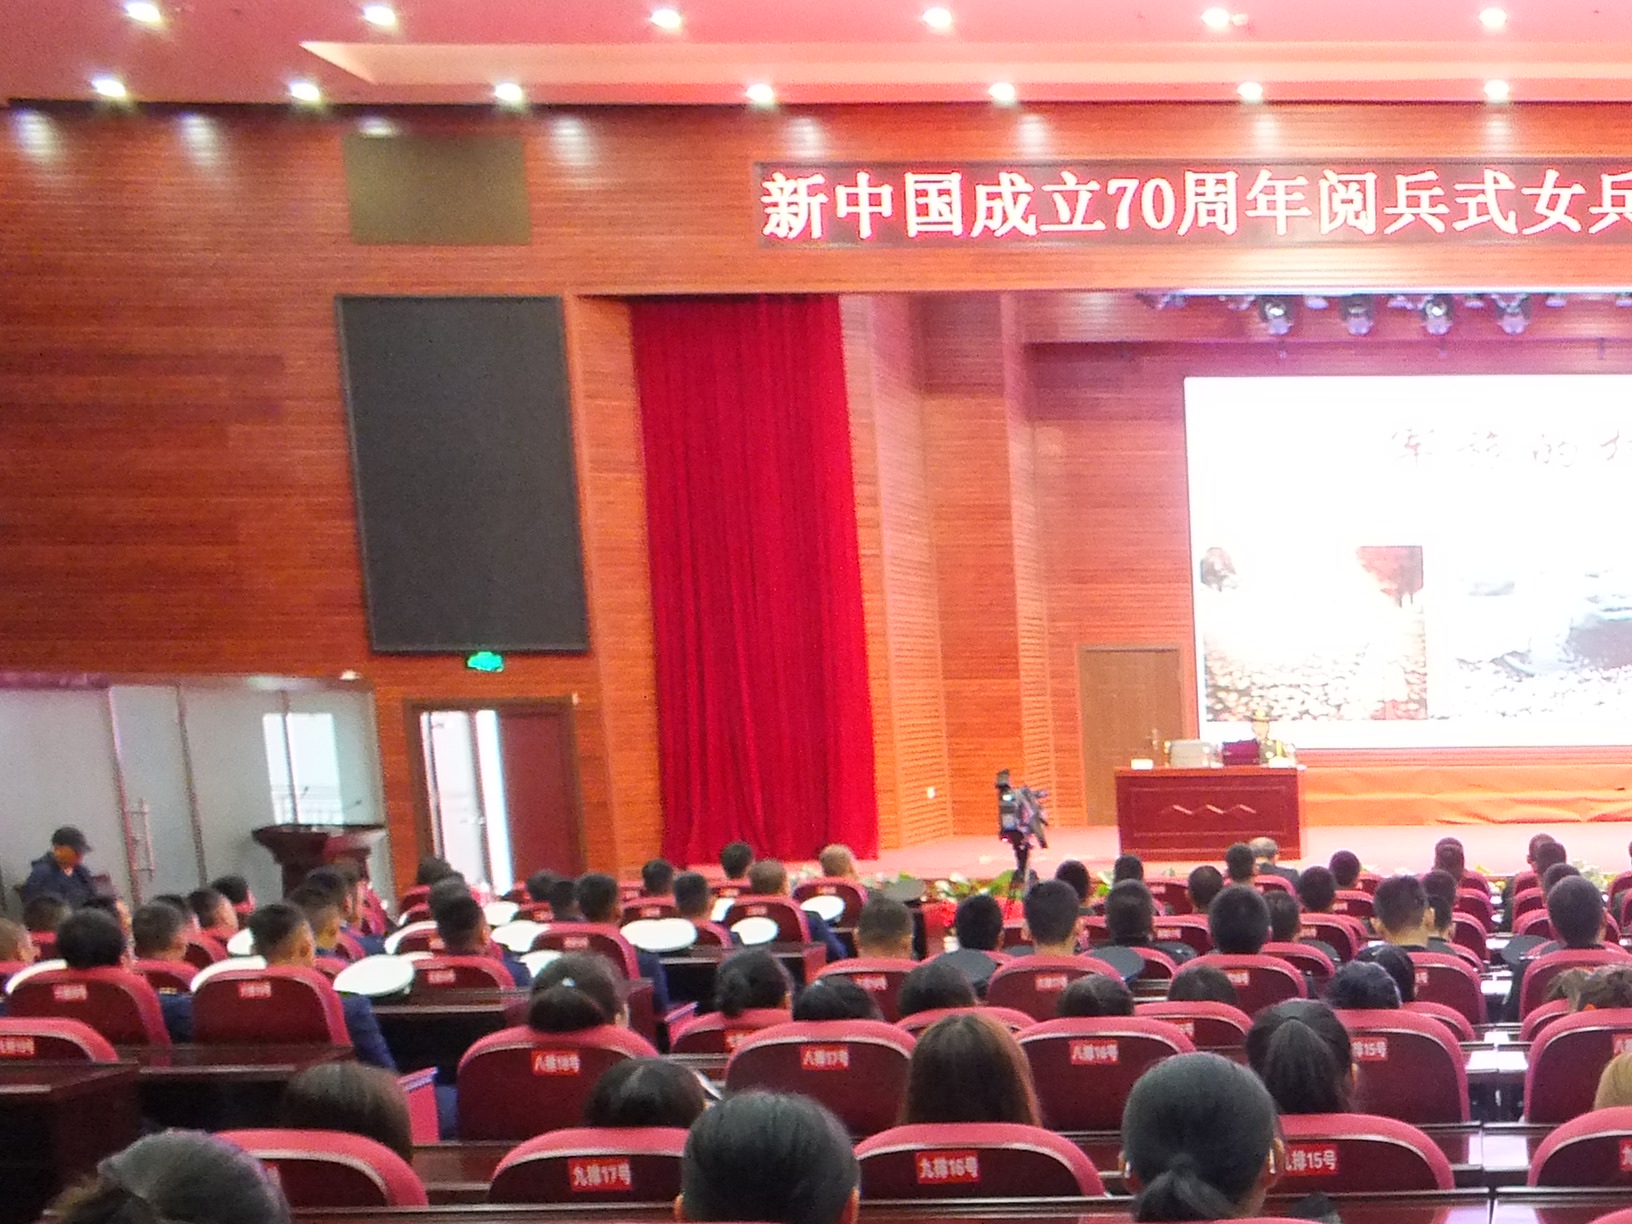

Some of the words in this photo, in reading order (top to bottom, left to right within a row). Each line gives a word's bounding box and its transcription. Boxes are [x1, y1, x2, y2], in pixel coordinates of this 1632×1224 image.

[573, 1162, 632, 1188] 九排17号
[919, 1155, 978, 1180] 九排16号
